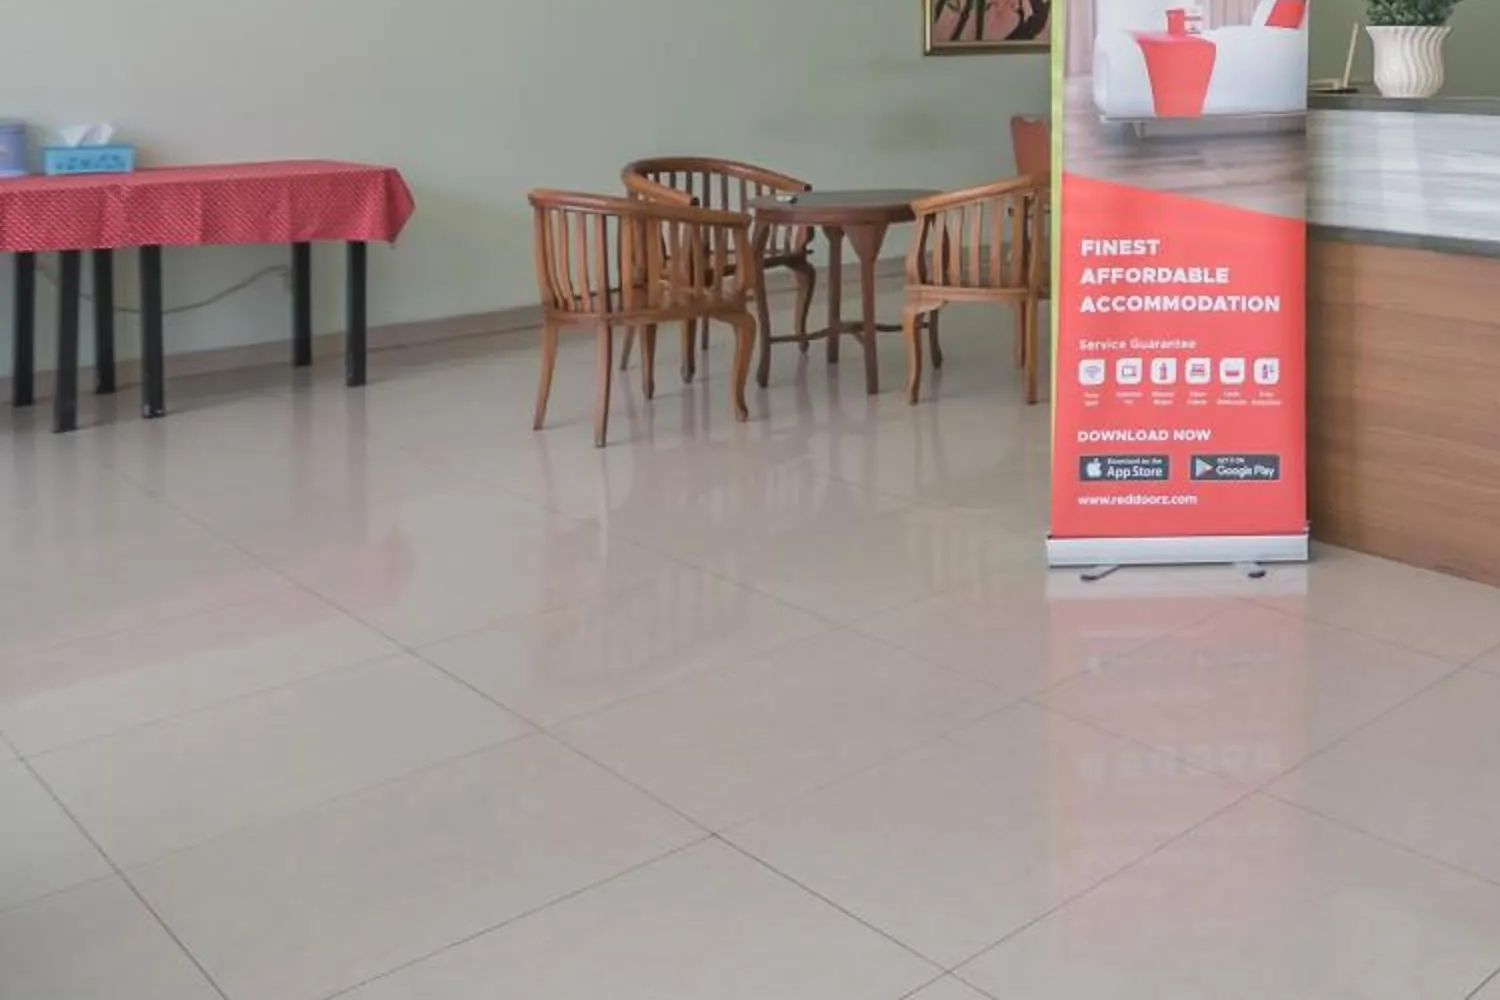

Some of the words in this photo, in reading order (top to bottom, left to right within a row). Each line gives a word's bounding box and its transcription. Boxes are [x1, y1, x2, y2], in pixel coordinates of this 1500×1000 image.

[1080, 239, 1160, 256] FINEST
[1080, 267, 1229, 284] AFFORDABLE
[1080, 295, 1281, 313] ACCOMMODATION
[1079, 339, 1127, 350] Service
[1130, 338, 1197, 350] Guarantee
[1077, 429, 1169, 442] DOWNLOAD
[1173, 429, 1211, 441] NOW
[1107, 465, 1132, 479] App
[1133, 465, 1163, 477] Store
[1215, 464, 1253, 479] Google
[1254, 464, 1275, 478] Play
[1078, 493, 1198, 506] www.reddoorz.com
